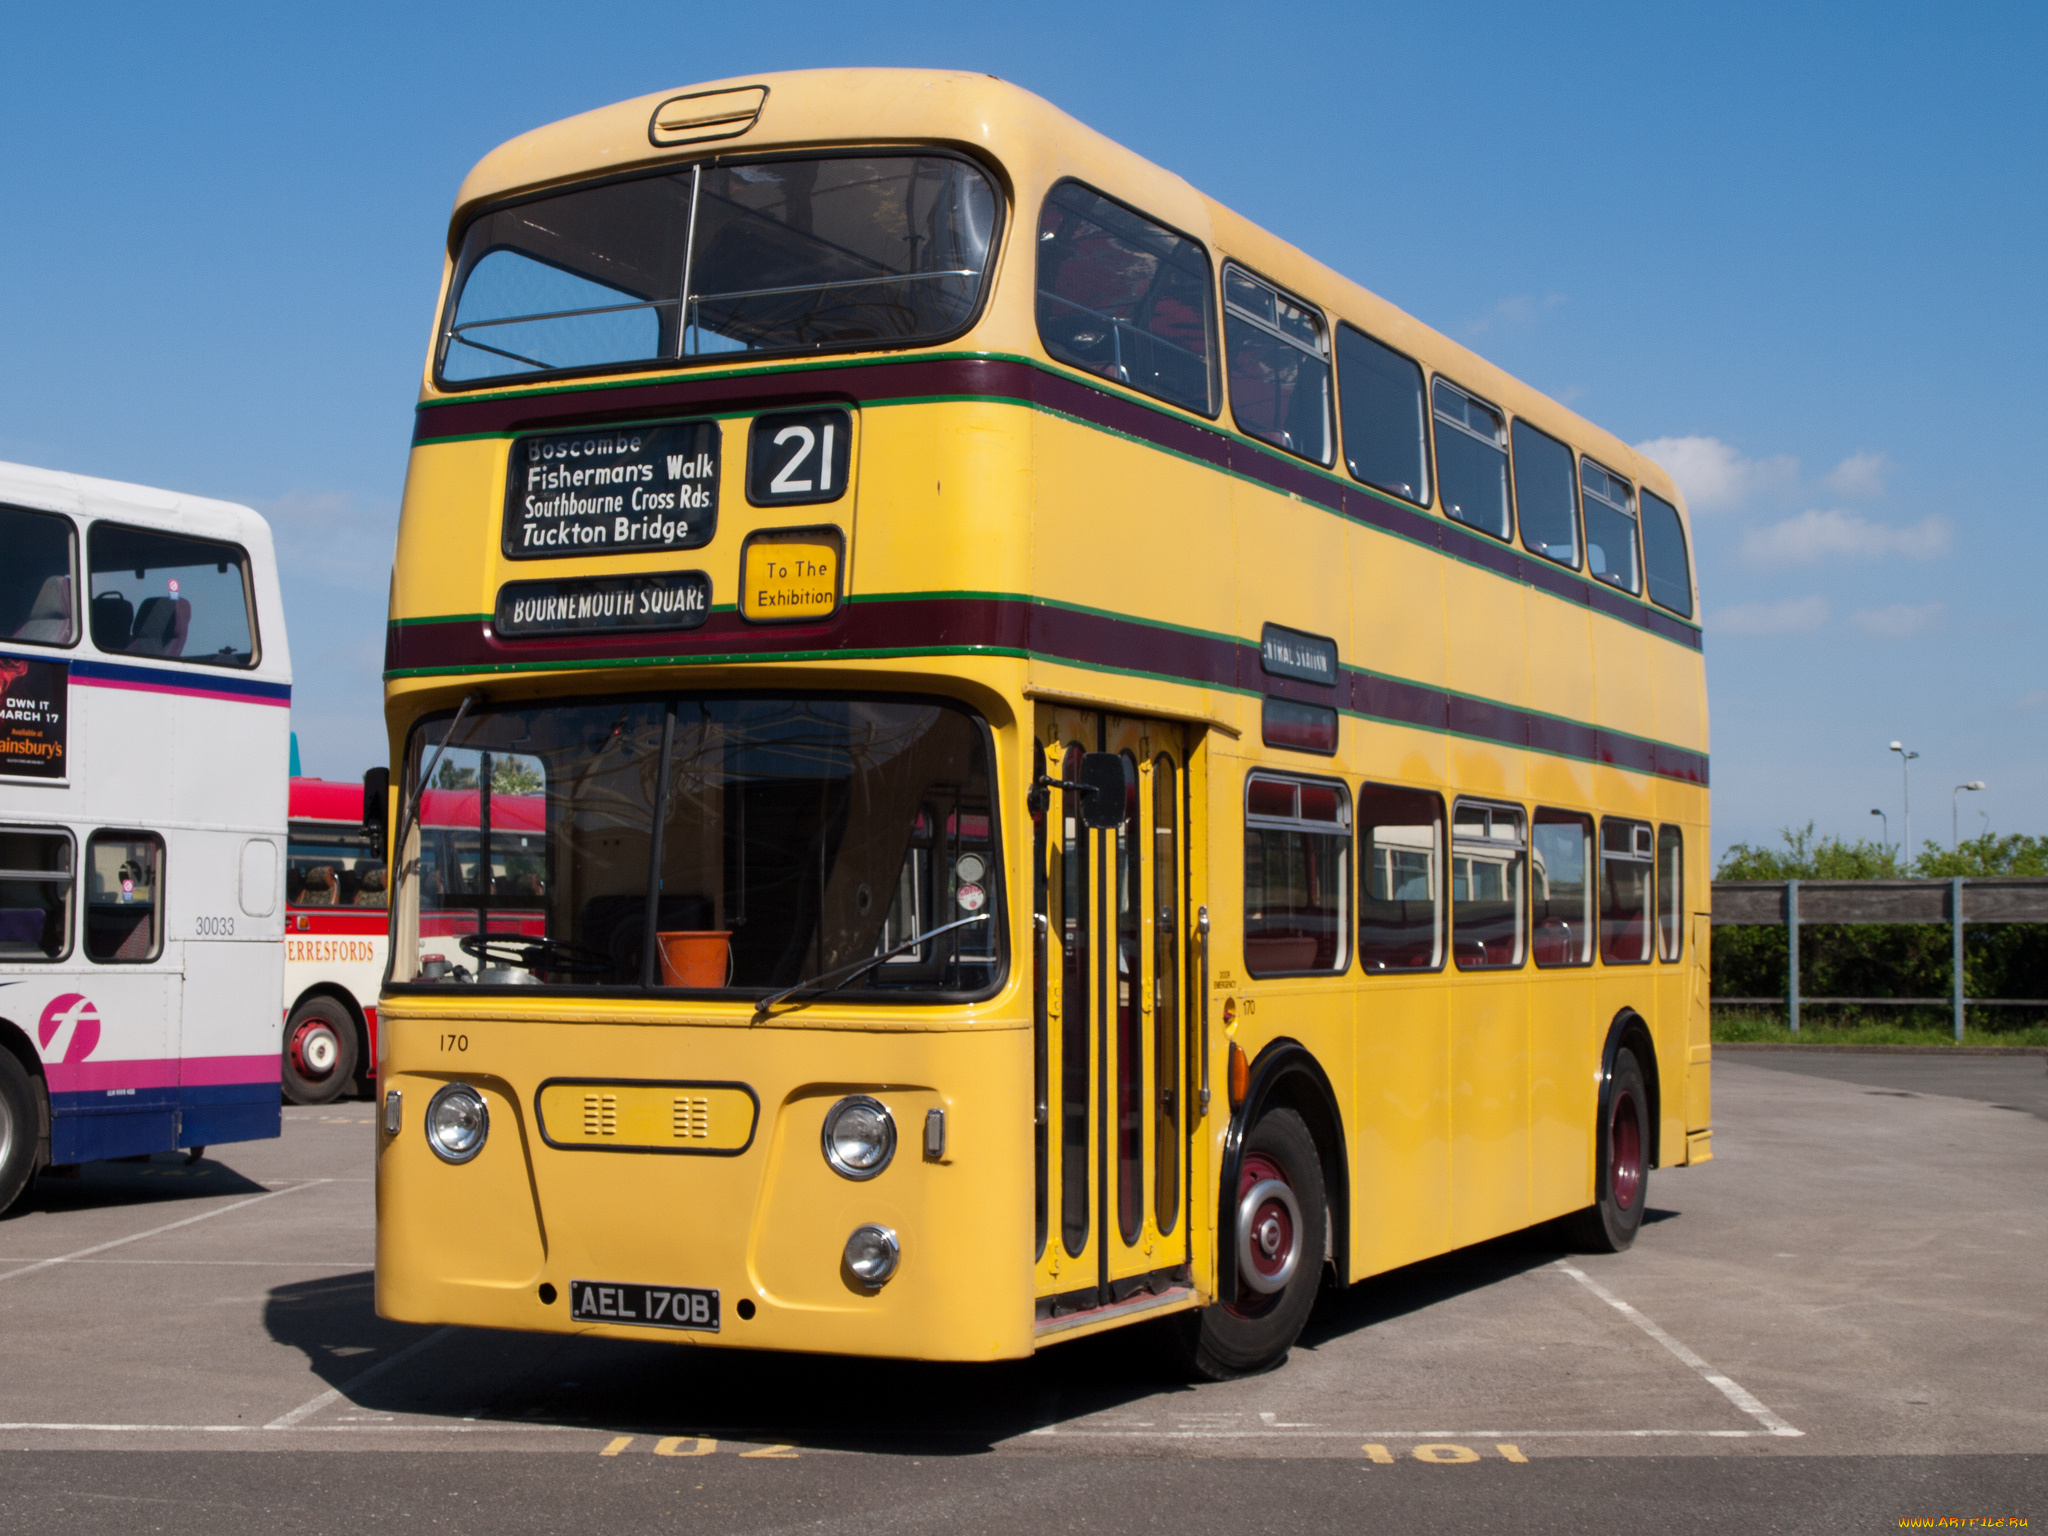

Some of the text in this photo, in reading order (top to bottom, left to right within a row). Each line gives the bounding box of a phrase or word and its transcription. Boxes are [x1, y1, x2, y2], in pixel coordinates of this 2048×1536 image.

[528, 436, 641, 461] Boscombe
[770, 425, 834, 493] 21
[528, 453, 713, 491] Fisherman's Walk
[525, 492, 623, 519] Southbourne
[632, 487, 675, 511] Cross
[523, 514, 688, 547] Tuckton Bridge
[767, 560, 827, 578] To The
[513, 585, 706, 623] BOURNEMOUTH SQUARE
[758, 588, 833, 607] Exhibition
[6, 697, 50, 710] OWN IT
[46, 713, 59, 723] 17
[195, 917, 235, 936] 30033
[286, 941, 373, 962] ERRESFORDS
[1243, 1000, 1256, 1016] 170
[440, 1034, 469, 1052] 170
[580, 1286, 710, 1323] AEL 170B
[1361, 1443, 1530, 1464] 101
